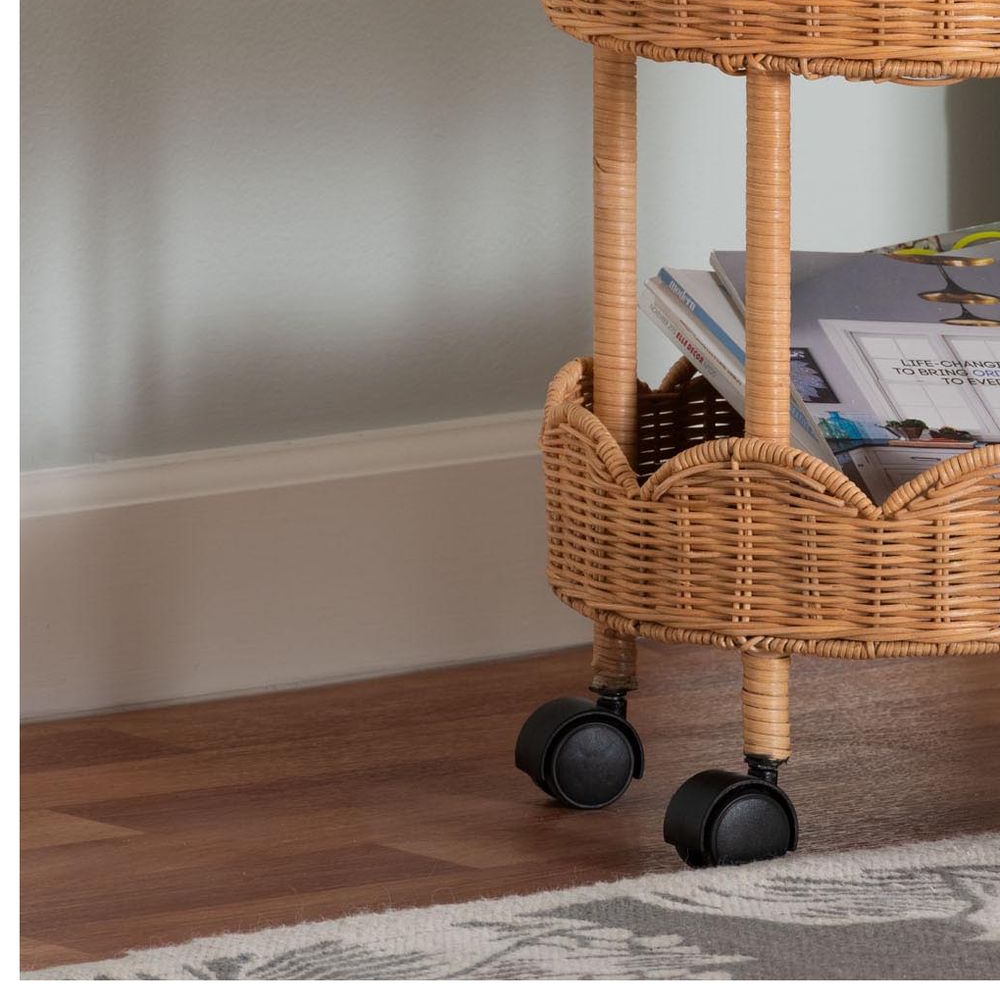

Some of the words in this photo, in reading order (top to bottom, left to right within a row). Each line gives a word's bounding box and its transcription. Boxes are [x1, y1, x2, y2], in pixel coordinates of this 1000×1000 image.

[676, 332, 688, 347] ELLE
[686, 343, 704, 363] DECOR
[893, 367, 915, 376] TO
[919, 368, 968, 377] BRING
[942, 377, 964, 386] TO
